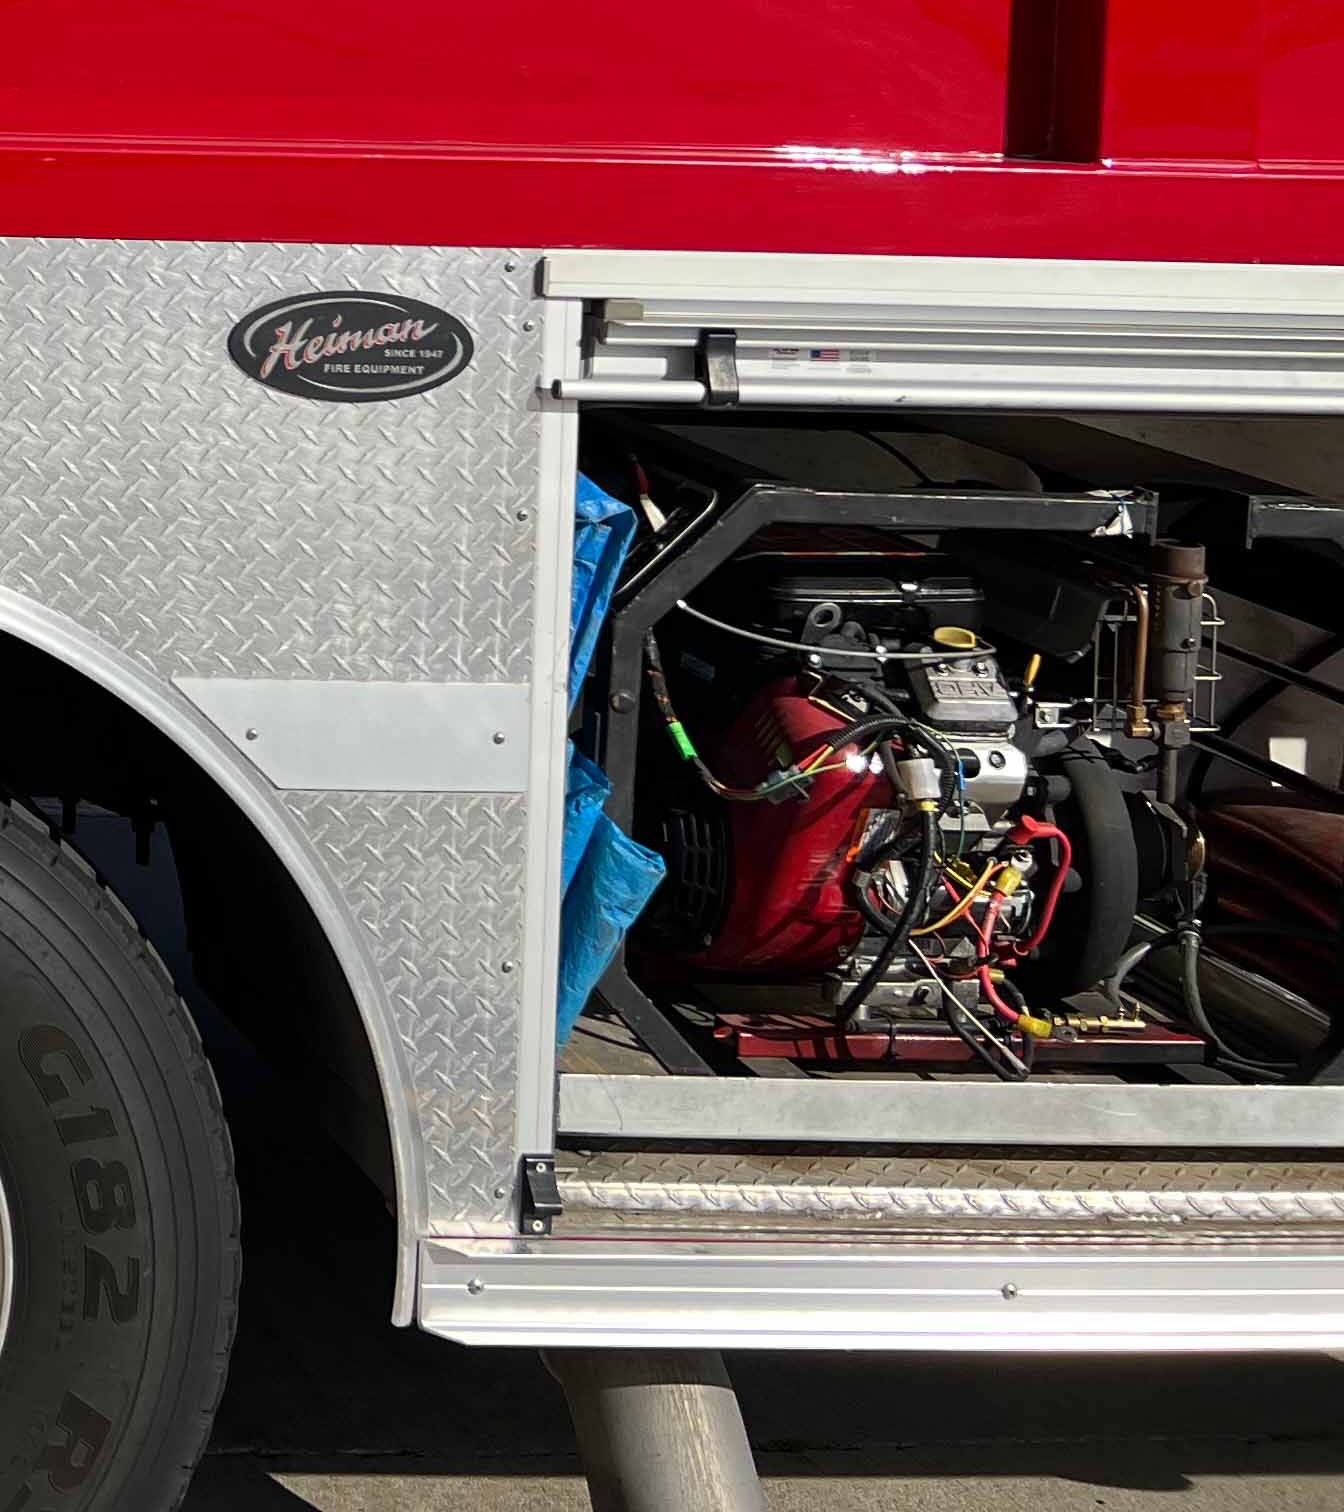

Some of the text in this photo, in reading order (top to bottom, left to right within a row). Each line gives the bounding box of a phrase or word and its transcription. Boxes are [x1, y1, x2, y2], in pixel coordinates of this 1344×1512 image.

[260, 314, 439, 378] Heiman
[384, 348, 444, 359] SINCE 1947
[323, 363, 425, 376] FIRE EQUIPMENT
[16, 1023, 142, 1327] G182
